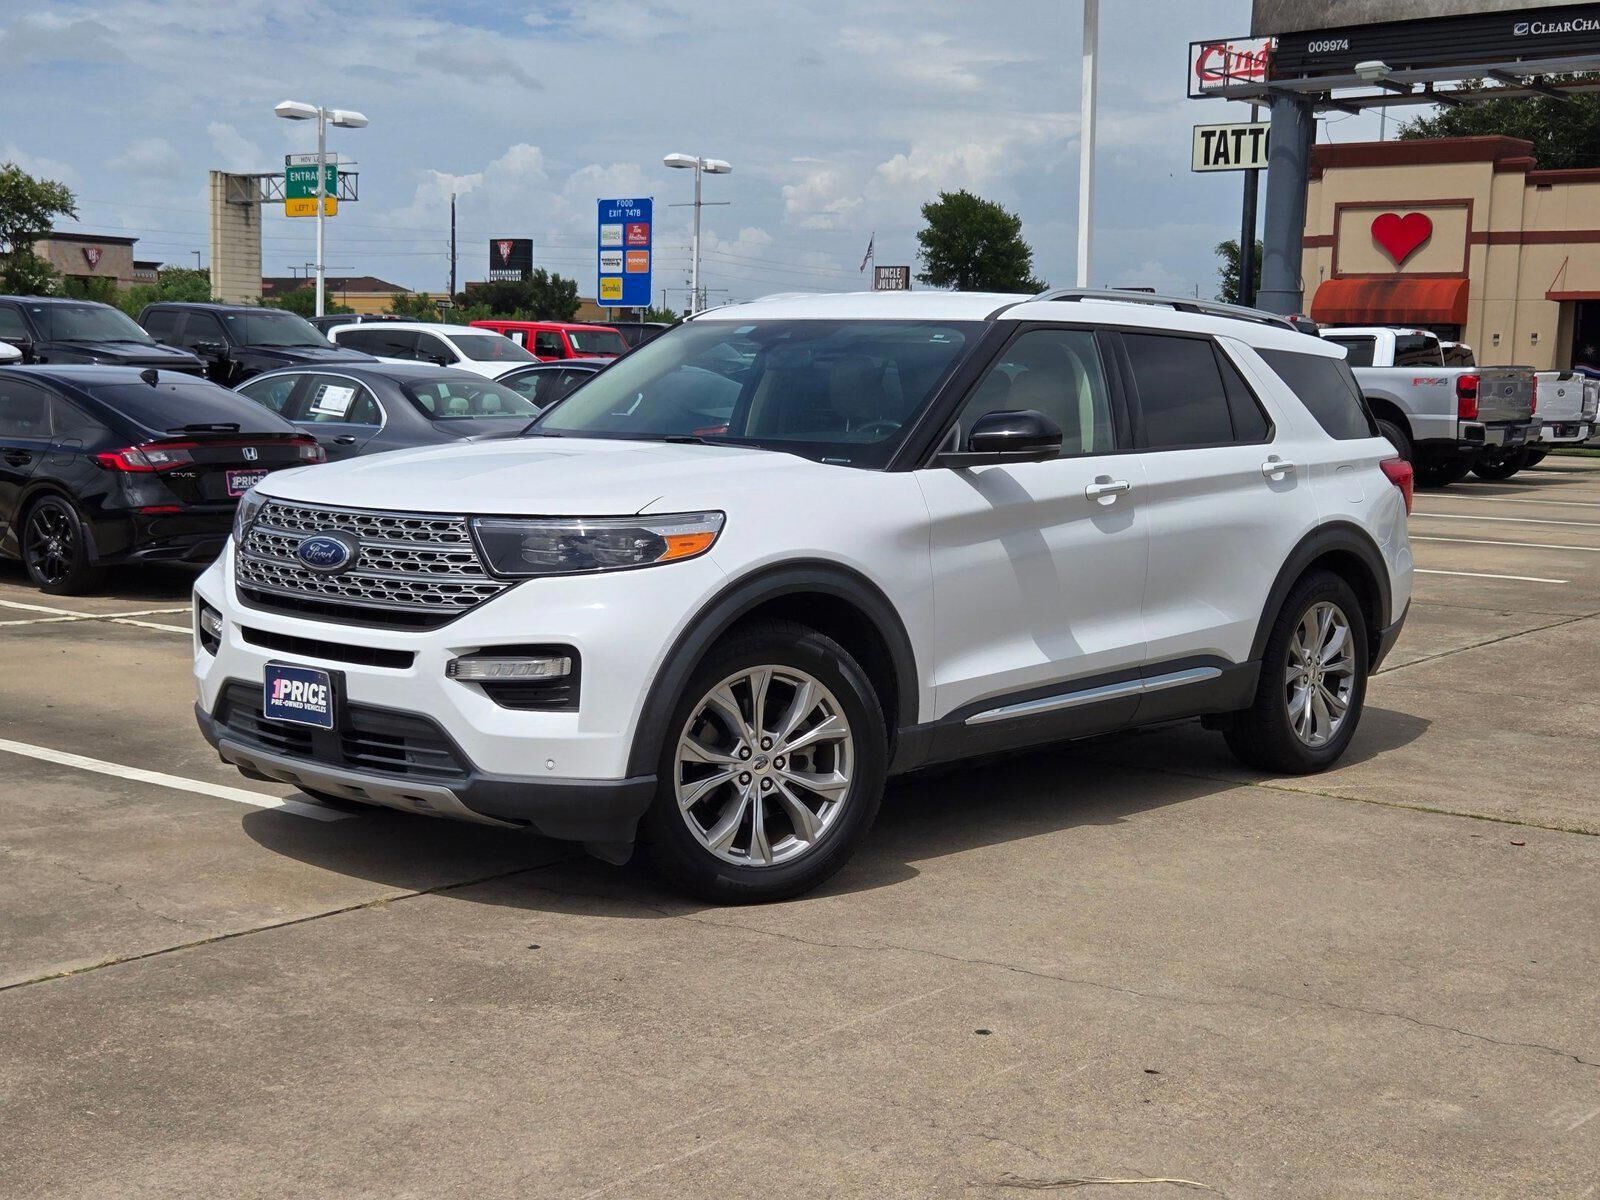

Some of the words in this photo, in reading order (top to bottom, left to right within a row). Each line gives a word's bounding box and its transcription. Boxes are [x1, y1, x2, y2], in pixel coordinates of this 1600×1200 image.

[1308, 39, 1349, 53] 009974
[290, 170, 333, 181] ENTRAE
[294, 204, 309, 212] LEFT
[312, 203, 329, 211] LAE
[616, 199, 634, 208] FOOD
[880, 268, 901, 279] UNCLE
[877, 279, 903, 289] JULIO'S
[306, 542, 336, 559] Ford
[272, 678, 327, 706] 1PRICE
[271, 698, 304, 709] PRE-OWNED
[304, 702, 326, 713] VEHICLES
